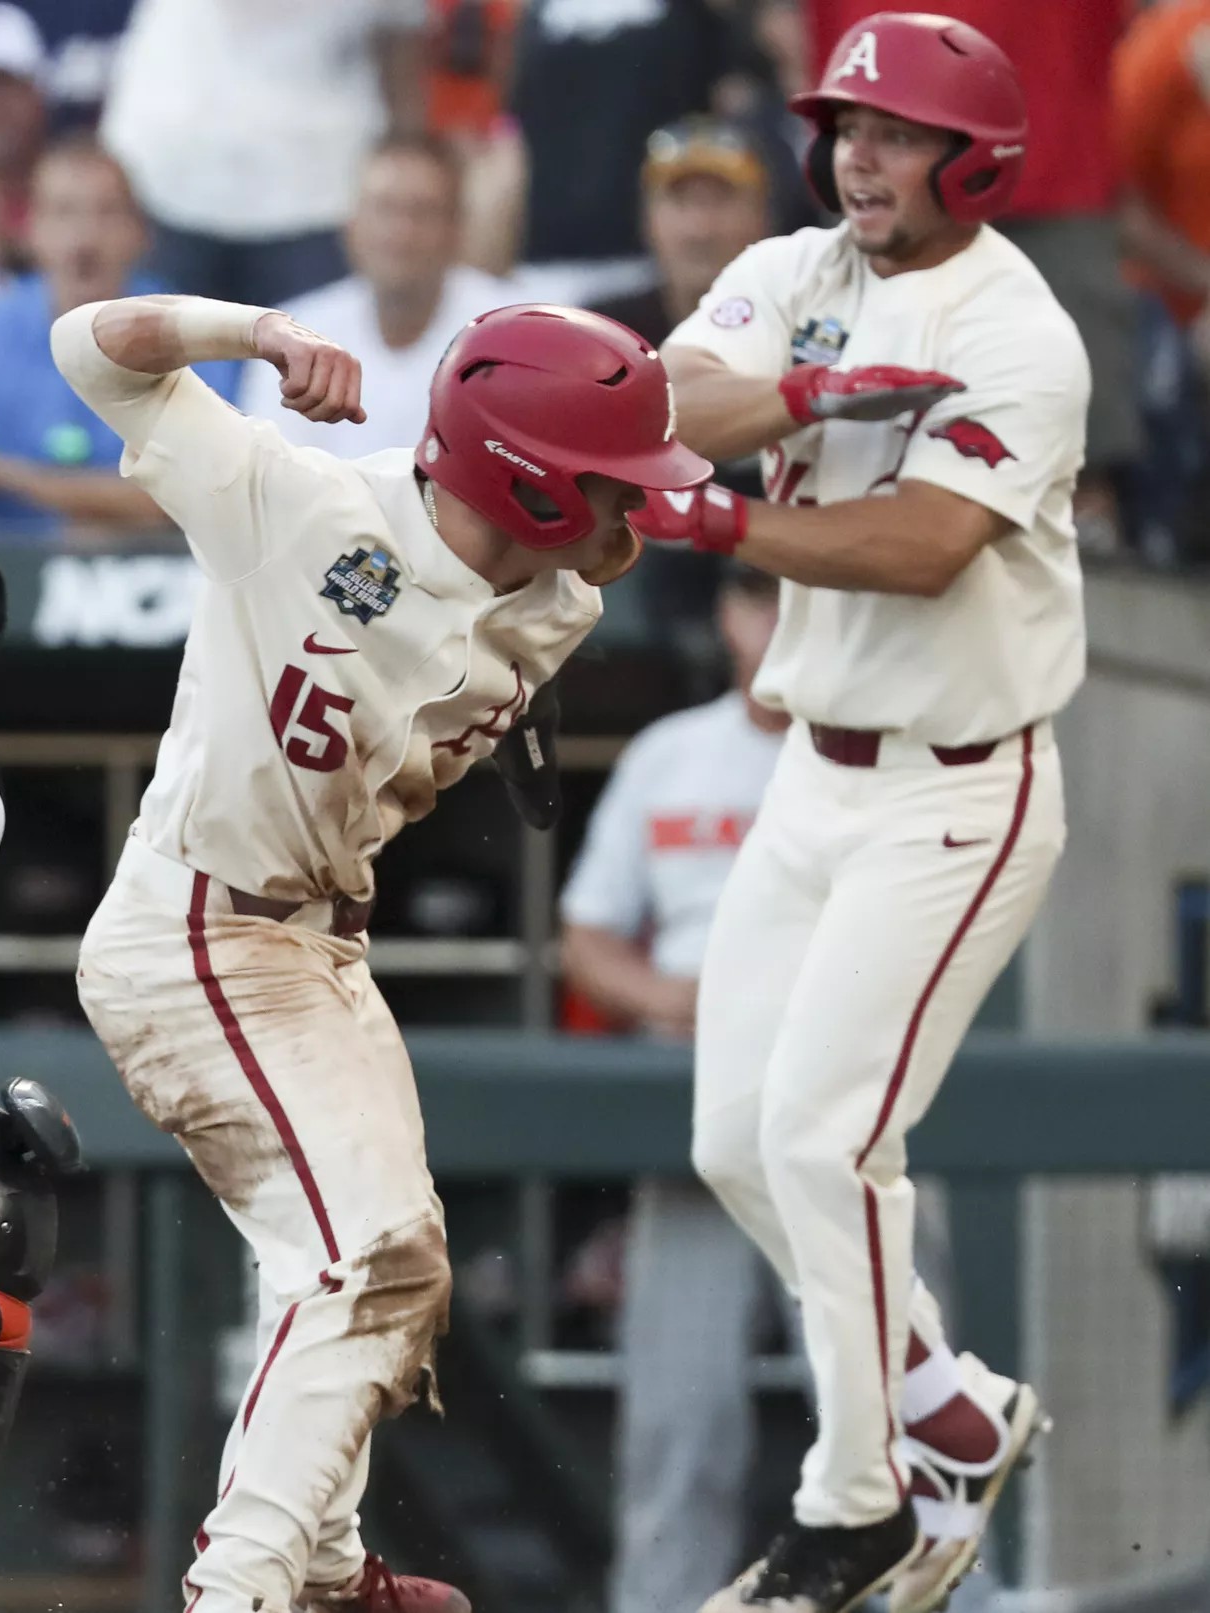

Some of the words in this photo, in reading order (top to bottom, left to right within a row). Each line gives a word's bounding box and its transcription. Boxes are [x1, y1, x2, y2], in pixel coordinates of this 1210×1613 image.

[828, 31, 879, 82] A
[495, 447, 547, 477] EASTON
[327, 570, 359, 594] WORLD
[355, 589, 388, 613] SERIES
[345, 570, 383, 597] COLLEGE
[269, 663, 356, 773] 15
